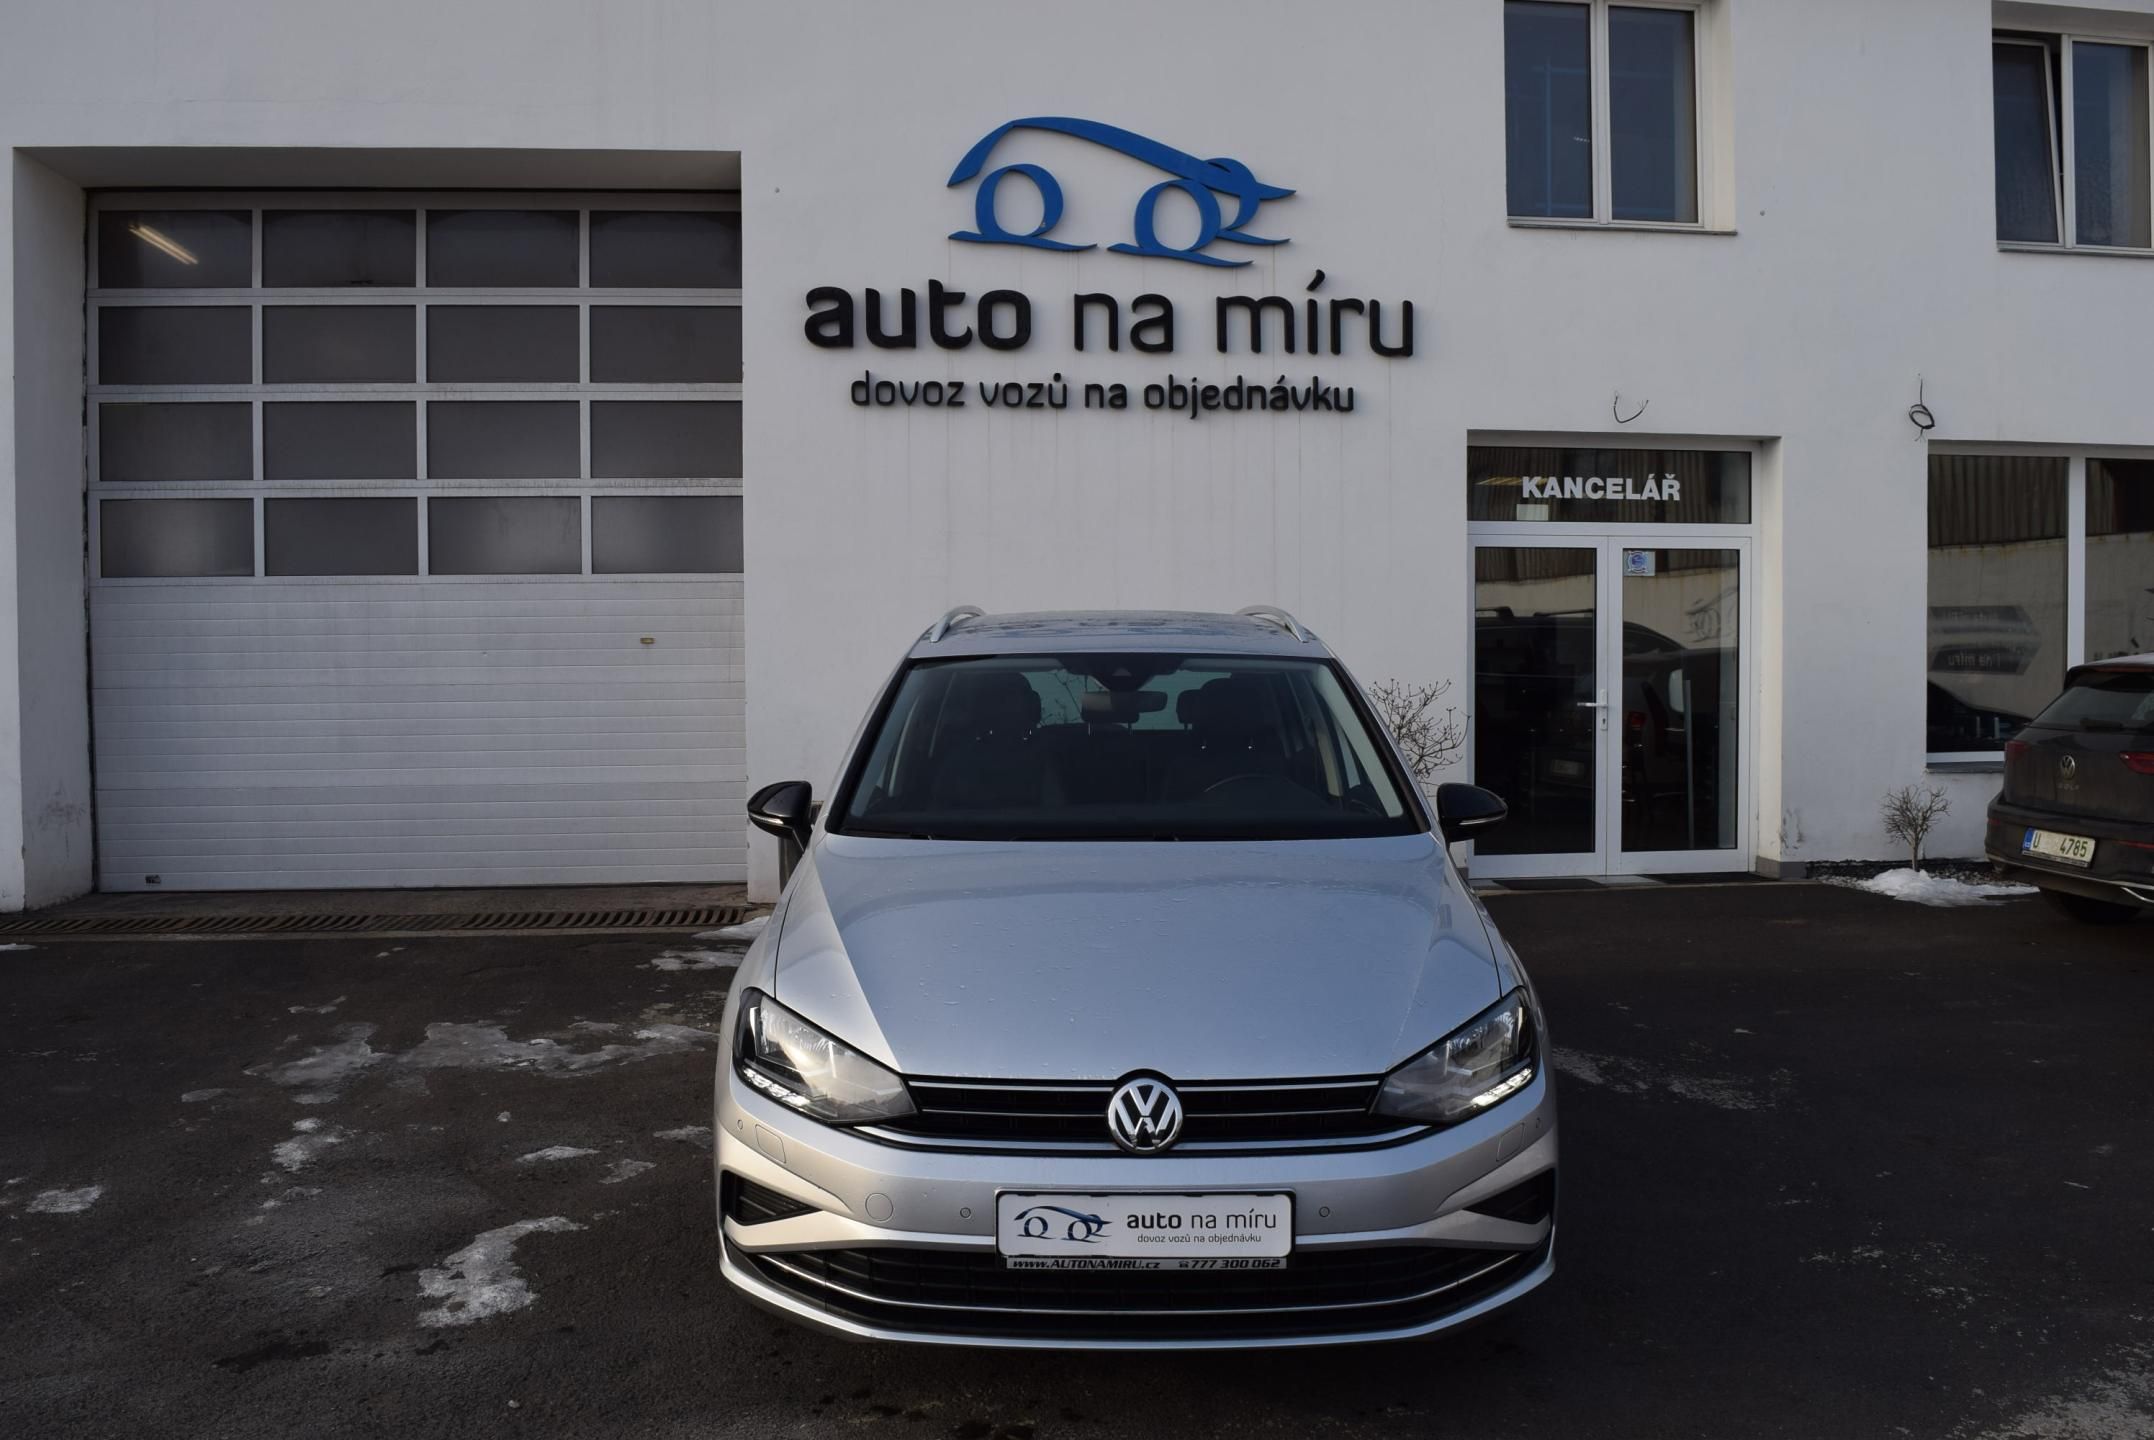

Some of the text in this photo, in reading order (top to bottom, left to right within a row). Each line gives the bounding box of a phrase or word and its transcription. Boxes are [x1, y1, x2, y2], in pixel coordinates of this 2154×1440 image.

[804, 268, 1415, 359] auto na míru
[850, 370, 1355, 419] dovoz vozů na objednávku
[1522, 473, 1681, 501] KANCELÁŘ
[2059, 836, 2089, 858] 4785
[1126, 1208, 1277, 1229] auto na míru
[1137, 1233, 1262, 1245] dovoz vozů na objednávku
[1013, 1258, 1281, 1269] www.AUTONAMIRU.cz 777 300 062
